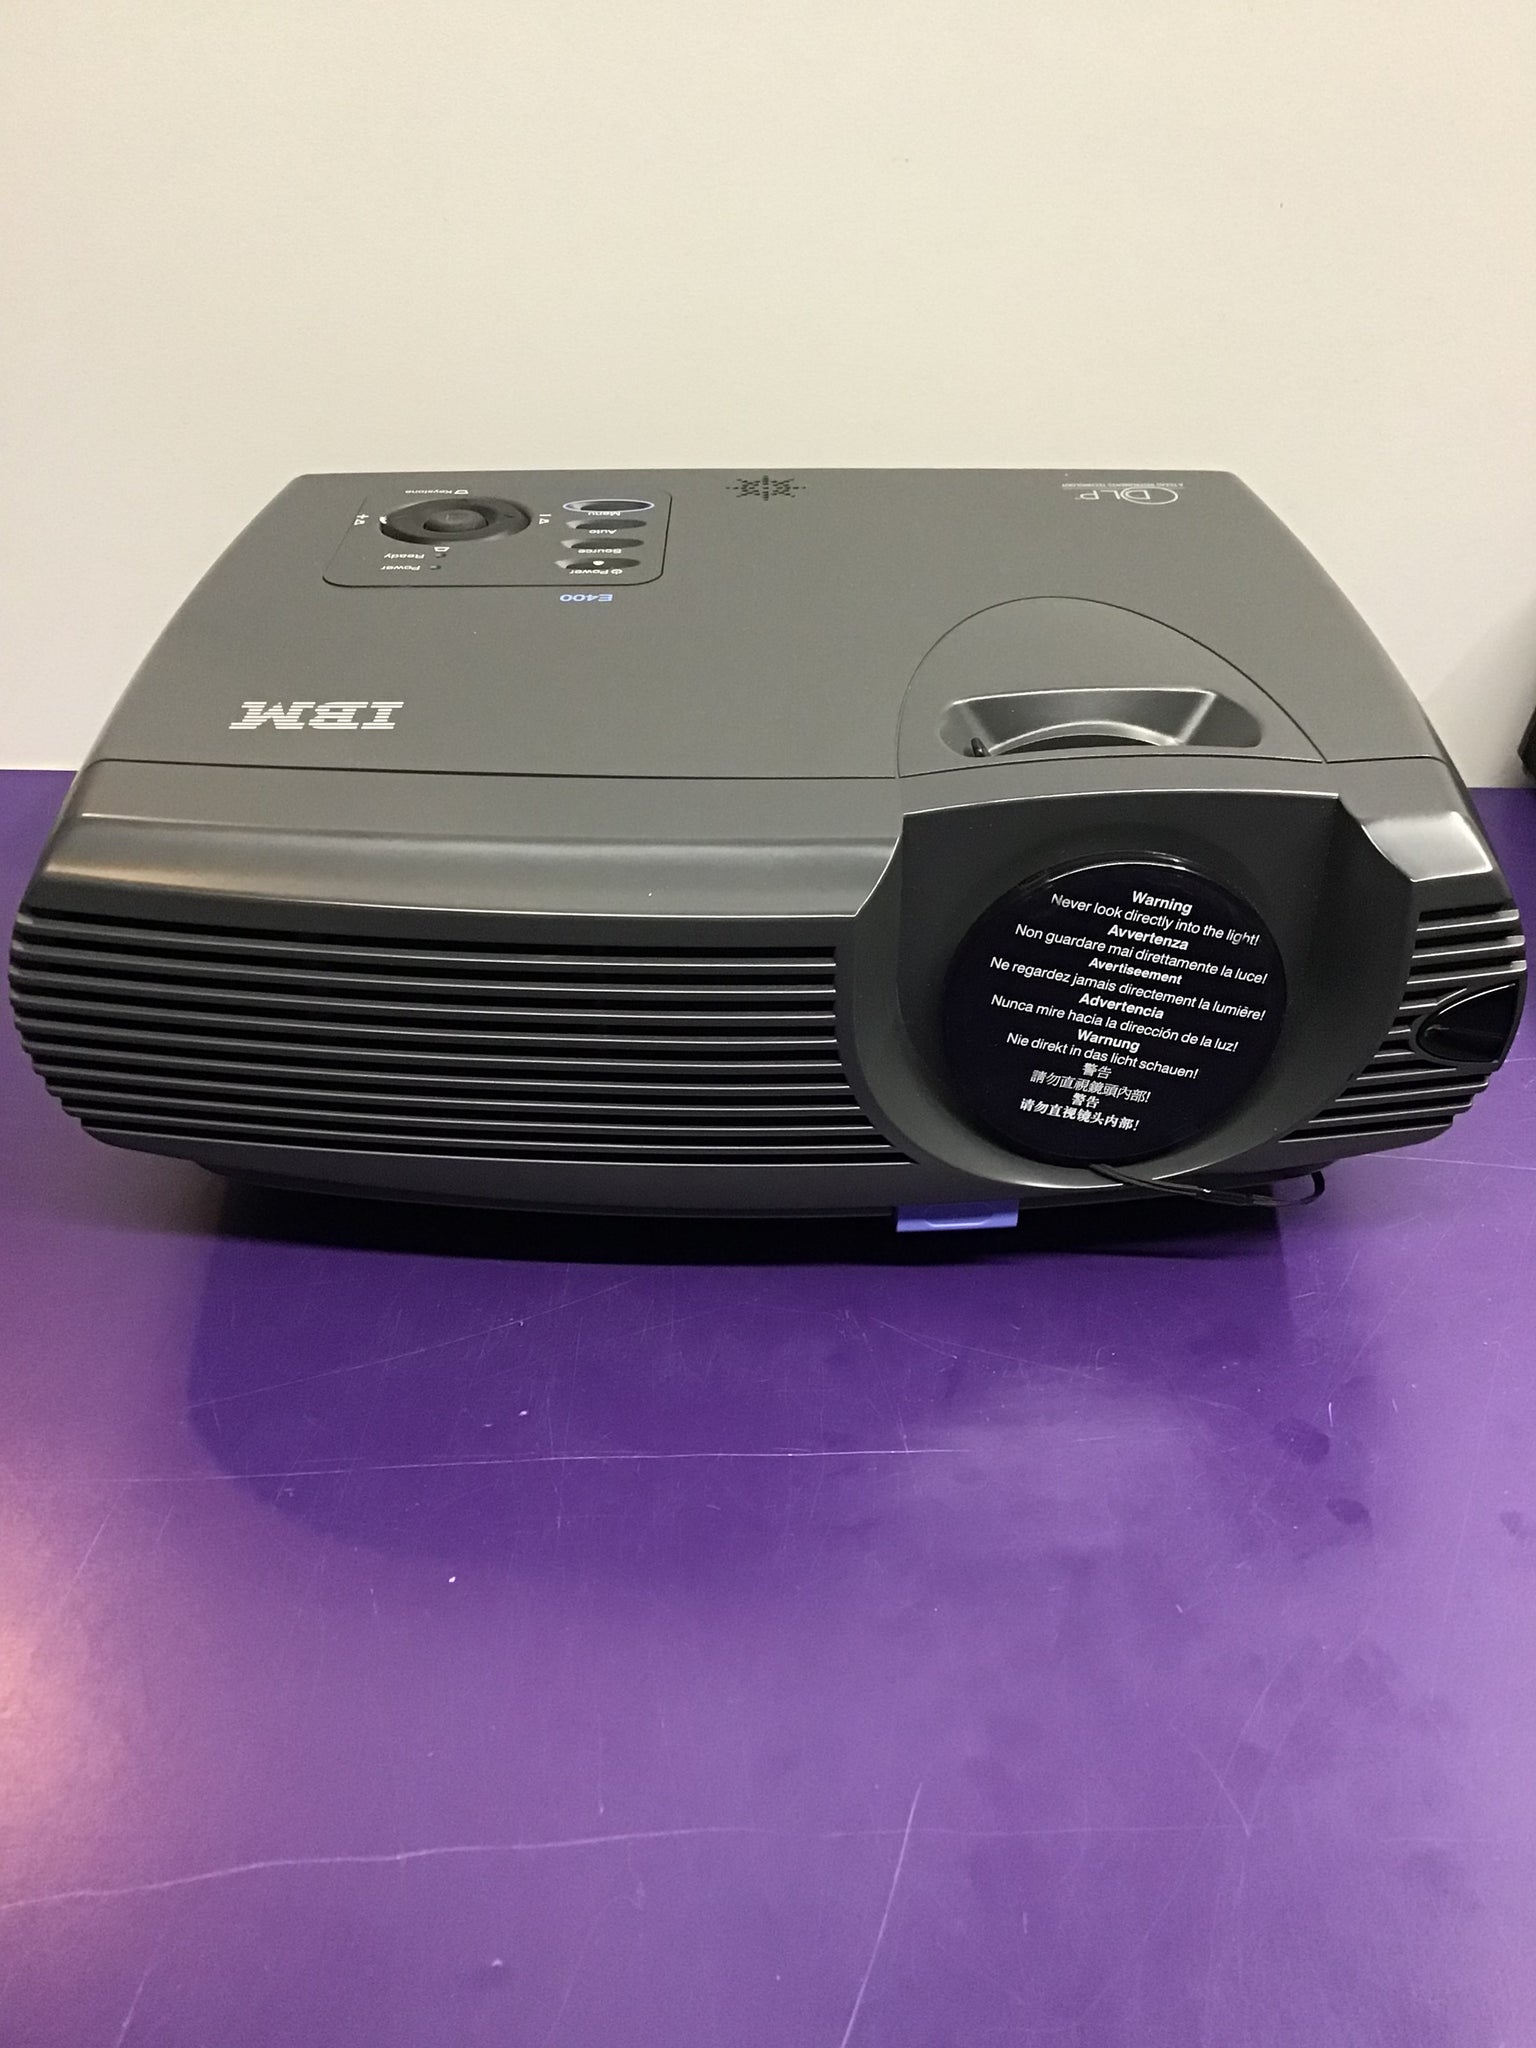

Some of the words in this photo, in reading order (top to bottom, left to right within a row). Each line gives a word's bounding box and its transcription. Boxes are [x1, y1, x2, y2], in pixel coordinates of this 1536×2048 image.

[560, 593, 614, 602] E400
[228, 701, 405, 730] IBM
[1132, 890, 1193, 916] Warning
[1051, 893, 1093, 913] Never
[1093, 902, 1122, 919] look
[1124, 909, 1174, 931] directly
[1175, 918, 1201, 935] into
[1202, 924, 1224, 940] the
[1225, 930, 1260, 947] light!
[1107, 924, 1190, 951] Avvertenza
[1015, 923, 1043, 939] Non
[1045, 931, 1106, 952] guardare
[1107, 944, 1134, 958] mai
[1135, 947, 1219, 976] direttamente
[1220, 964, 1233, 978] la
[1234, 968, 1268, 985] luce!
[990, 956, 1010, 971] Ne
[1011, 962, 1071, 983] regardez
[1070, 973, 1117, 992] jamais
[1118, 983, 1198, 1008] directement
[1198, 997, 1210, 1011] la
[1088, 957, 1183, 985] Avertiseement
[1078, 992, 1165, 1020] Advertencia
[990, 994, 1035, 1013] Nunca
[1035, 1005, 1066, 1019] mire
[1067, 1009, 1103, 1026] hacia
[1105, 1015, 1117, 1029] la
[1119, 1019, 1179, 1041] dirección
[1180, 1032, 1199, 1047] de
[1200, 1035, 1212, 1049] la
[1213, 1039, 1239, 1053] luz!
[1077, 1029, 1141, 1053] Warnung
[1006, 1032, 1030, 1047] Nie
[1031, 1038, 1068, 1055] direkt
[1069, 1044, 1082, 1057] in
[1084, 1048, 1108, 1062] das
[1110, 1052, 1137, 1068] licht
[1138, 1059, 1199, 1080] schauen!
[1082, 1063, 1112, 1079] 警告
[1071, 1093, 1100, 1109] 警告
